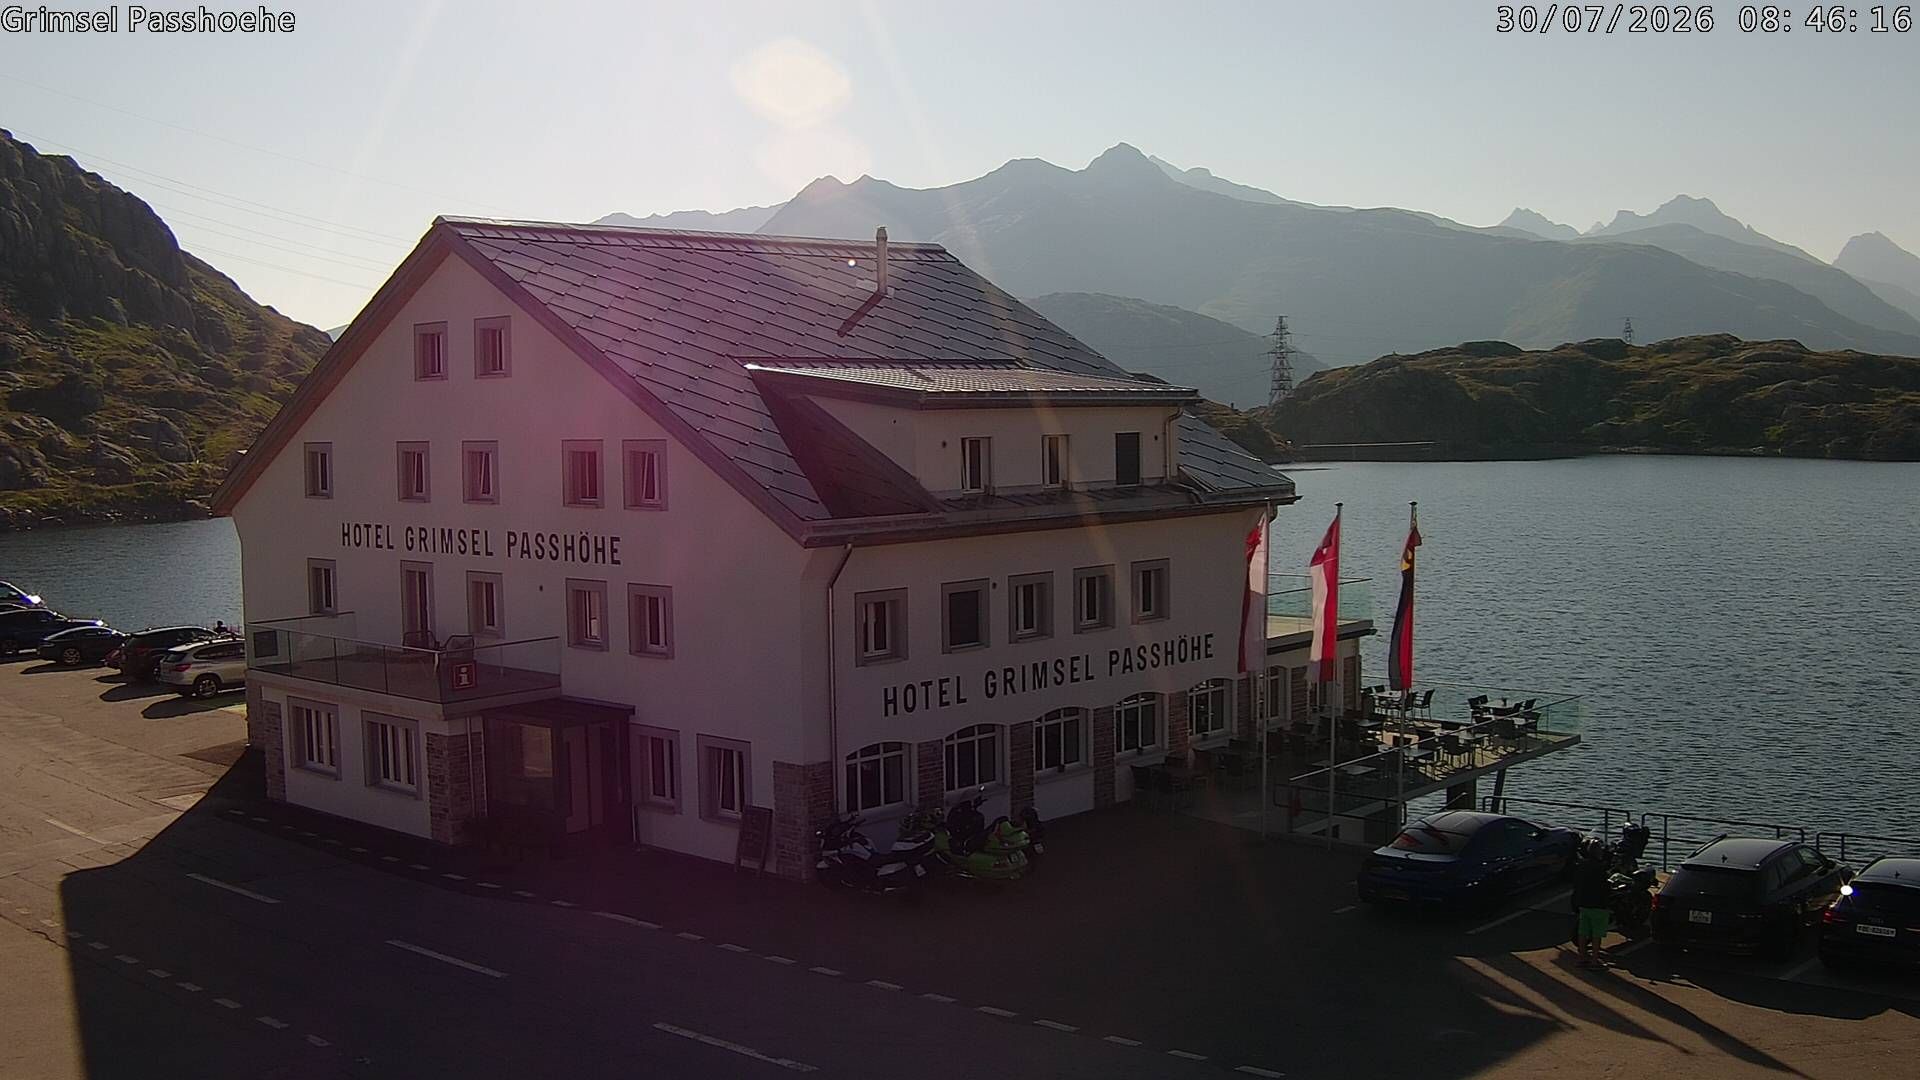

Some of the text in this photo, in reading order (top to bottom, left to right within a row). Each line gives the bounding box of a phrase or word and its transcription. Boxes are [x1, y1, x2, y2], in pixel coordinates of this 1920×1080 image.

[341, 523, 621, 565] HOTEL GRIMSEL PASSHÖHE
[883, 633, 1214, 717] HOTEL GRIMSEL PASSHÖHE
